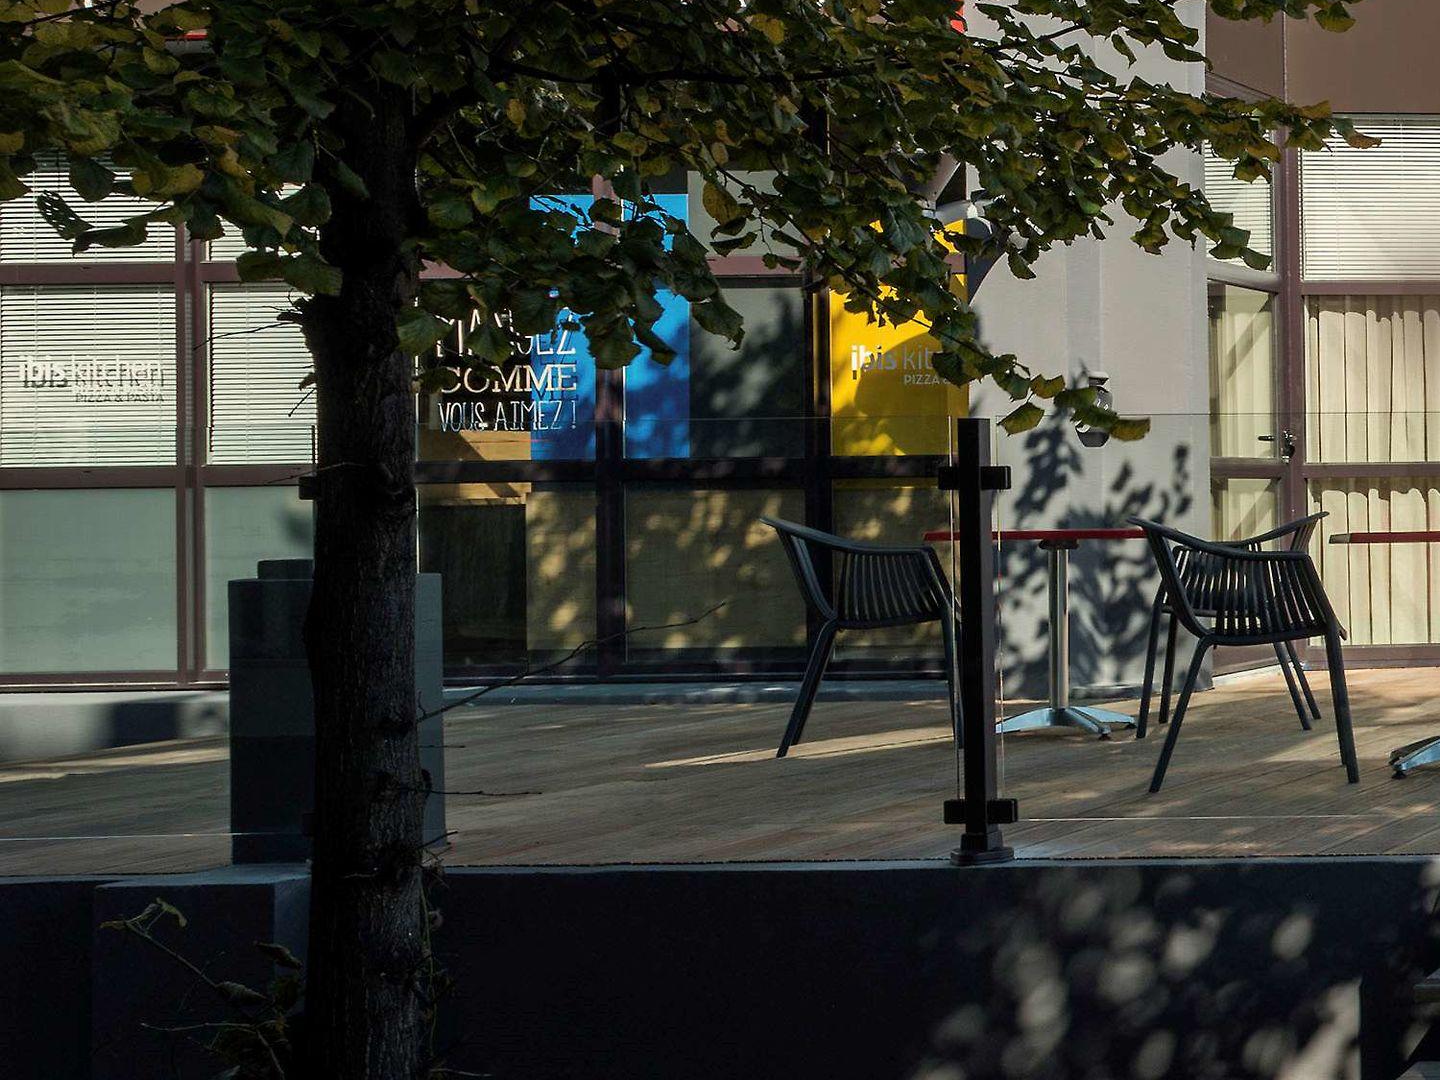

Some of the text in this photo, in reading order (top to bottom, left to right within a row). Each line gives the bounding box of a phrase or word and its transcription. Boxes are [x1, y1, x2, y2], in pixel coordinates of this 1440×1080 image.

[850, 344, 897, 371] ibis
[904, 374, 940, 386] PIZZA
[437, 401, 489, 432] VOUS
[493, 401, 563, 432] AIMEZ
